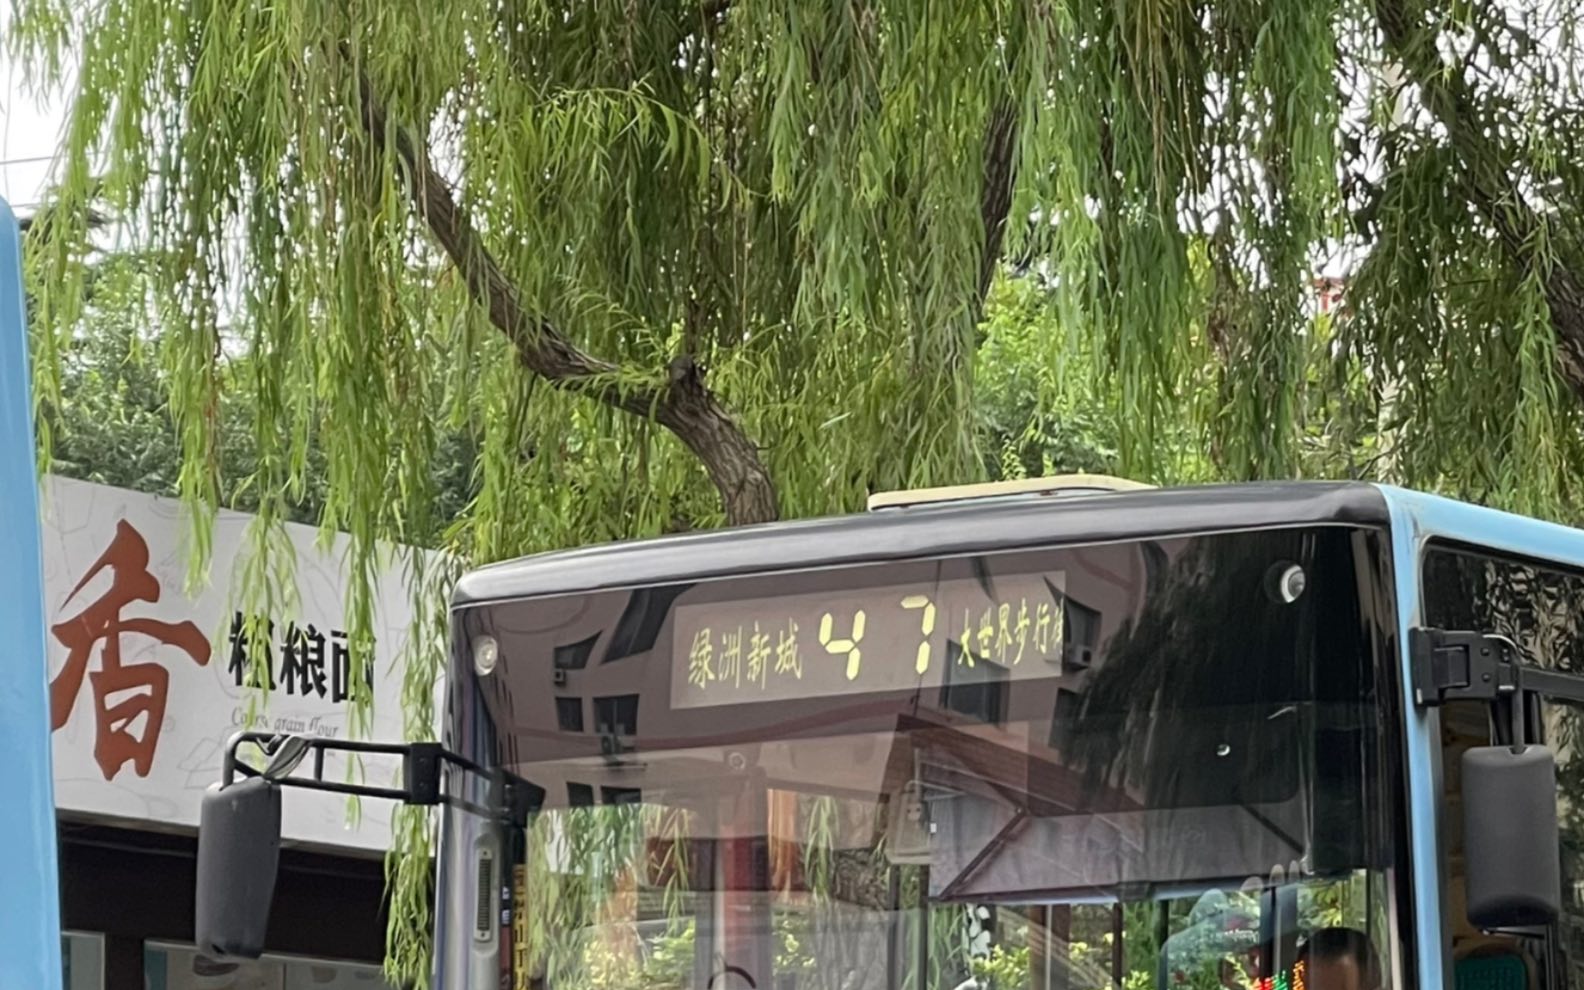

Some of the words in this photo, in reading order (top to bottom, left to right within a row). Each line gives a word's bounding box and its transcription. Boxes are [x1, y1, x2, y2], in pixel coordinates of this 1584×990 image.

[50, 518, 212, 782] 香
[688, 617, 802, 690] 绿洲新城
